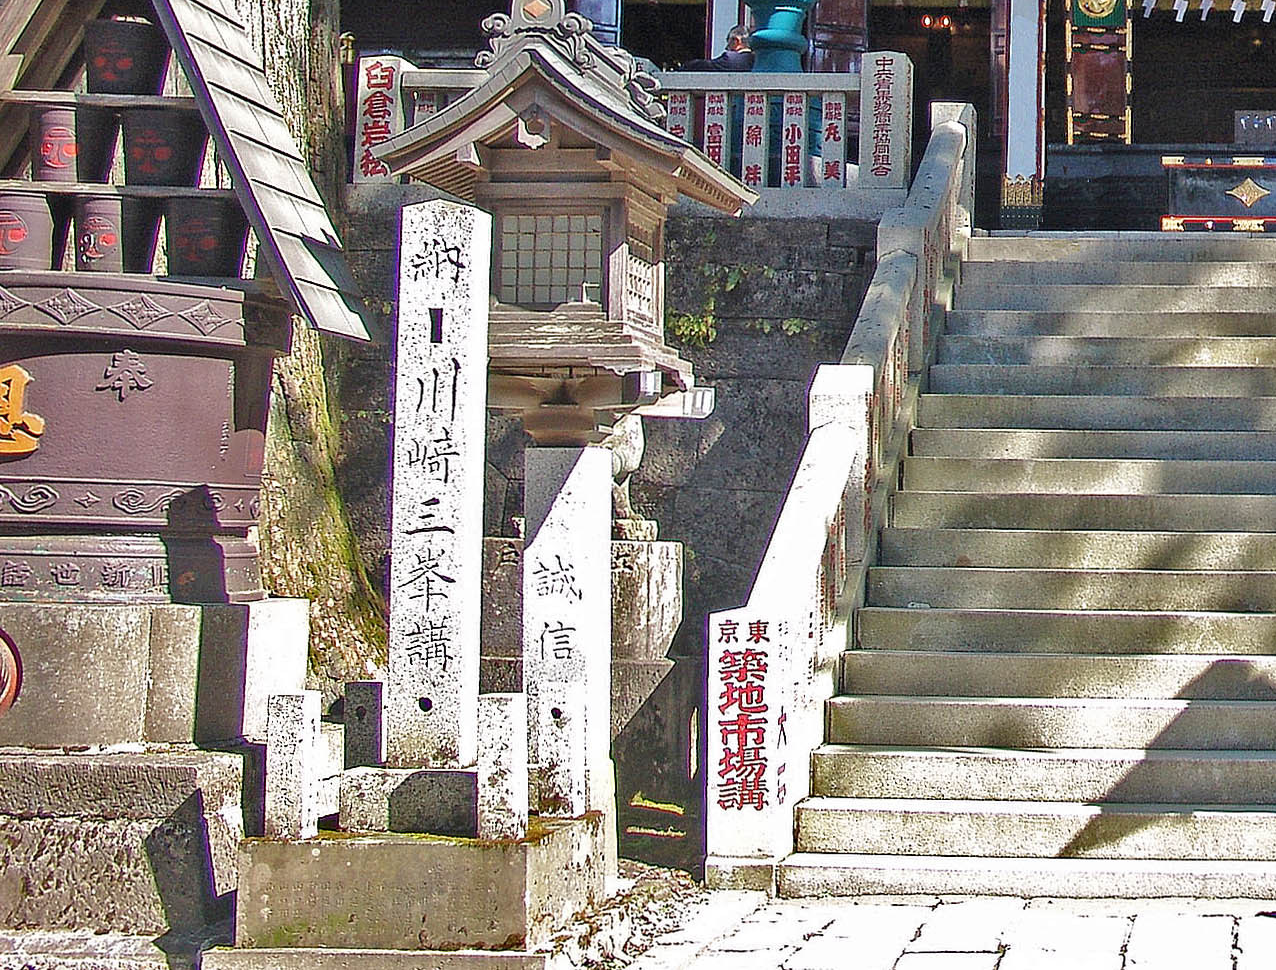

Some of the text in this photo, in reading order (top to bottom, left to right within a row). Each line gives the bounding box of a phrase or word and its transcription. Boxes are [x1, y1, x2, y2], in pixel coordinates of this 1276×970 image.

[717, 649, 770, 811] 築地市場講
